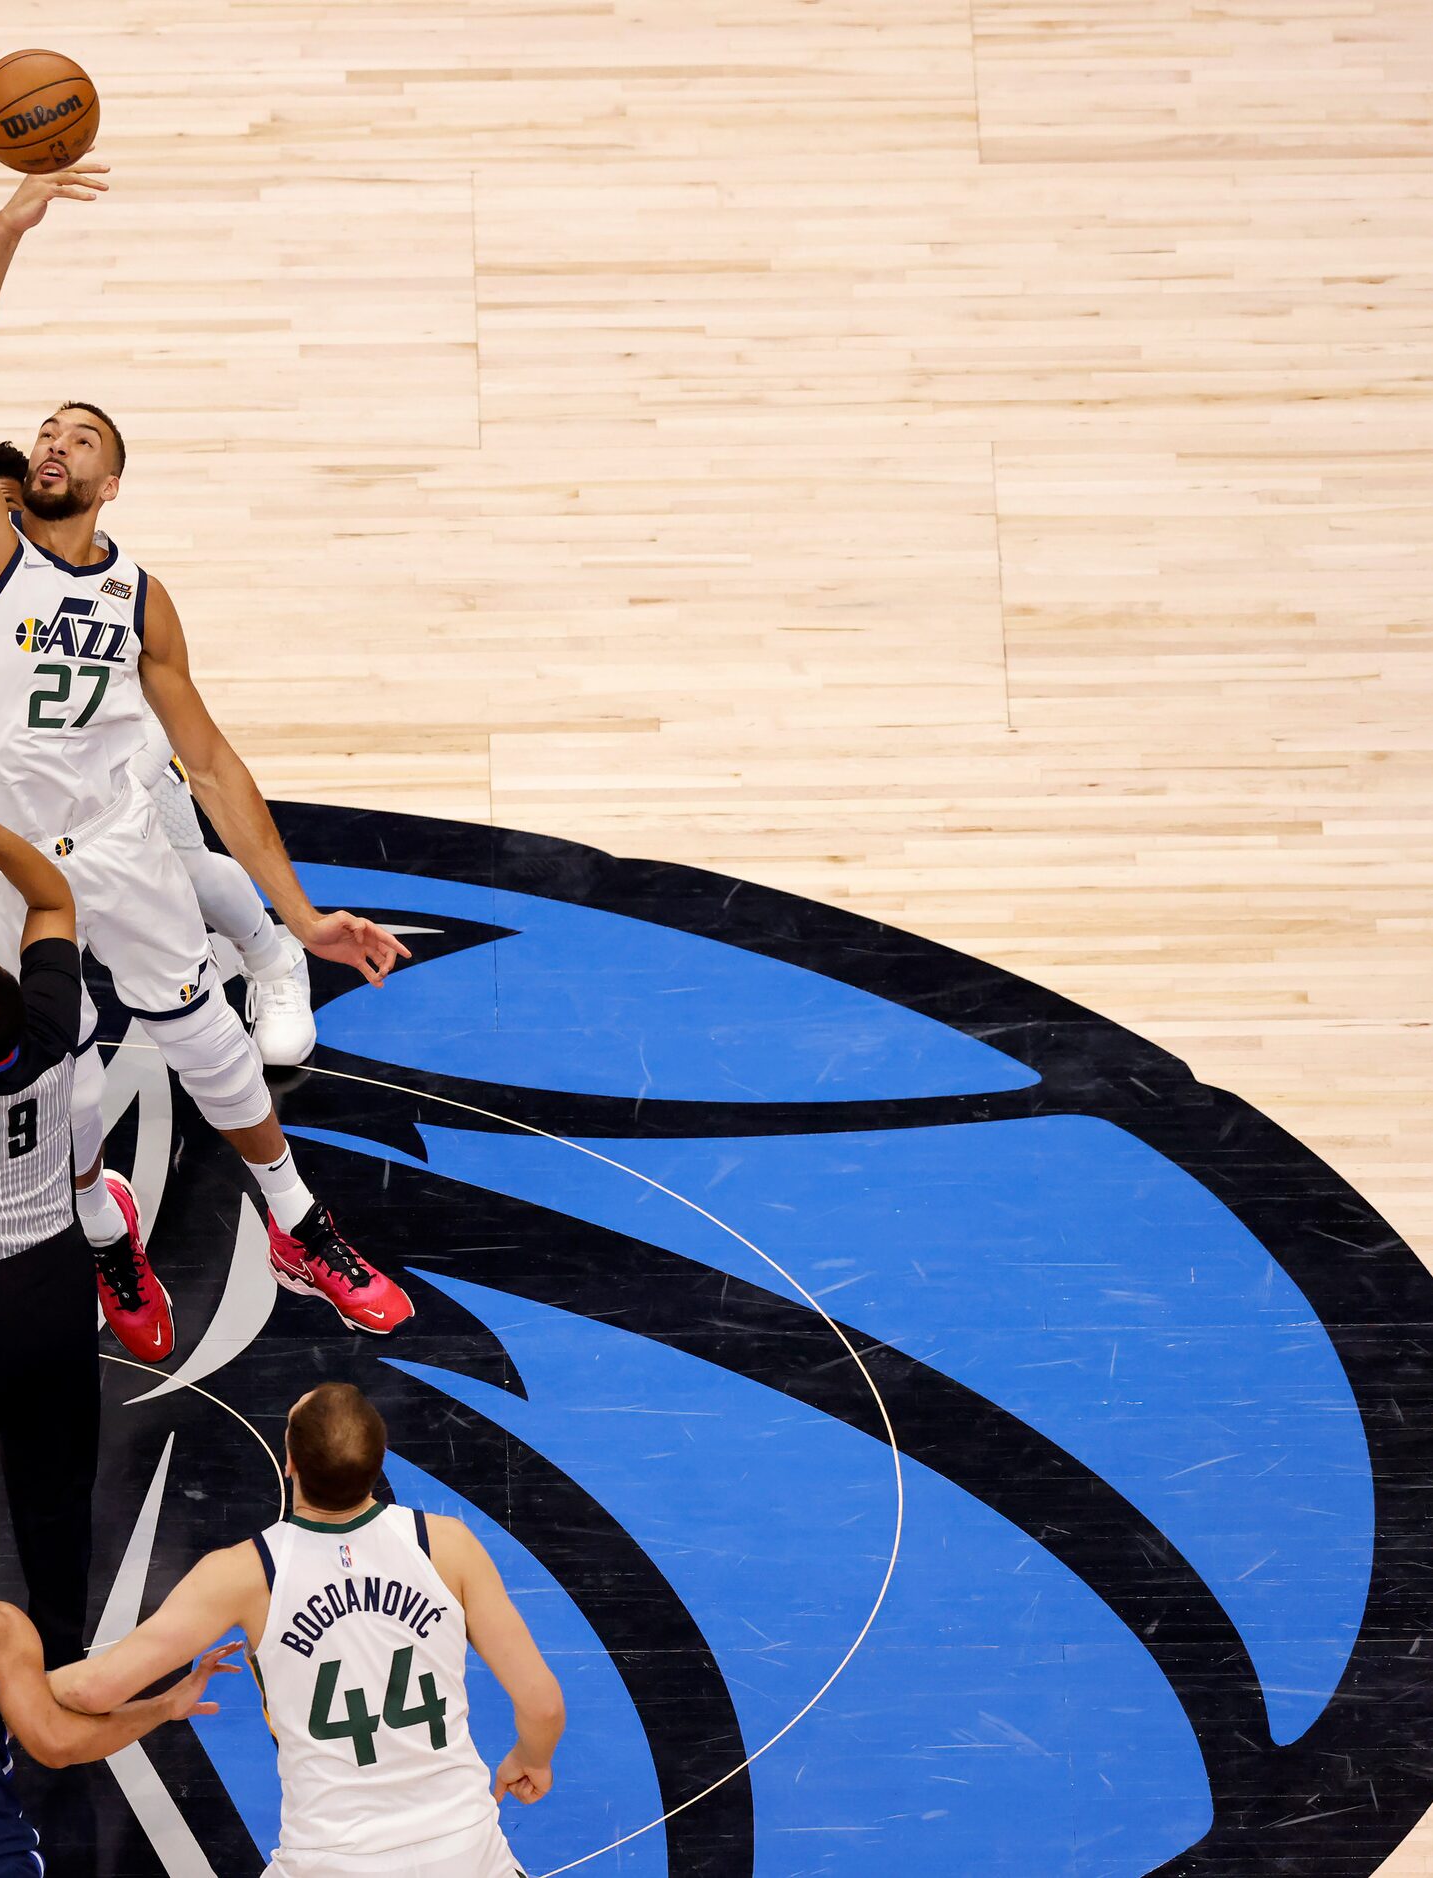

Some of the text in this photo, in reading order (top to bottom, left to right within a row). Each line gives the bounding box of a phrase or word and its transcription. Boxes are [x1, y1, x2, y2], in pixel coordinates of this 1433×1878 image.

[0, 94, 84, 139] Wilson
[102, 580, 114, 592] 5
[111, 588, 130, 599] FIGHT
[15, 596, 131, 663] JAZZ
[28, 663, 110, 729] 27
[280, 1577, 448, 1659] BOGDANOVIĆ
[308, 1645, 448, 1767] 44
